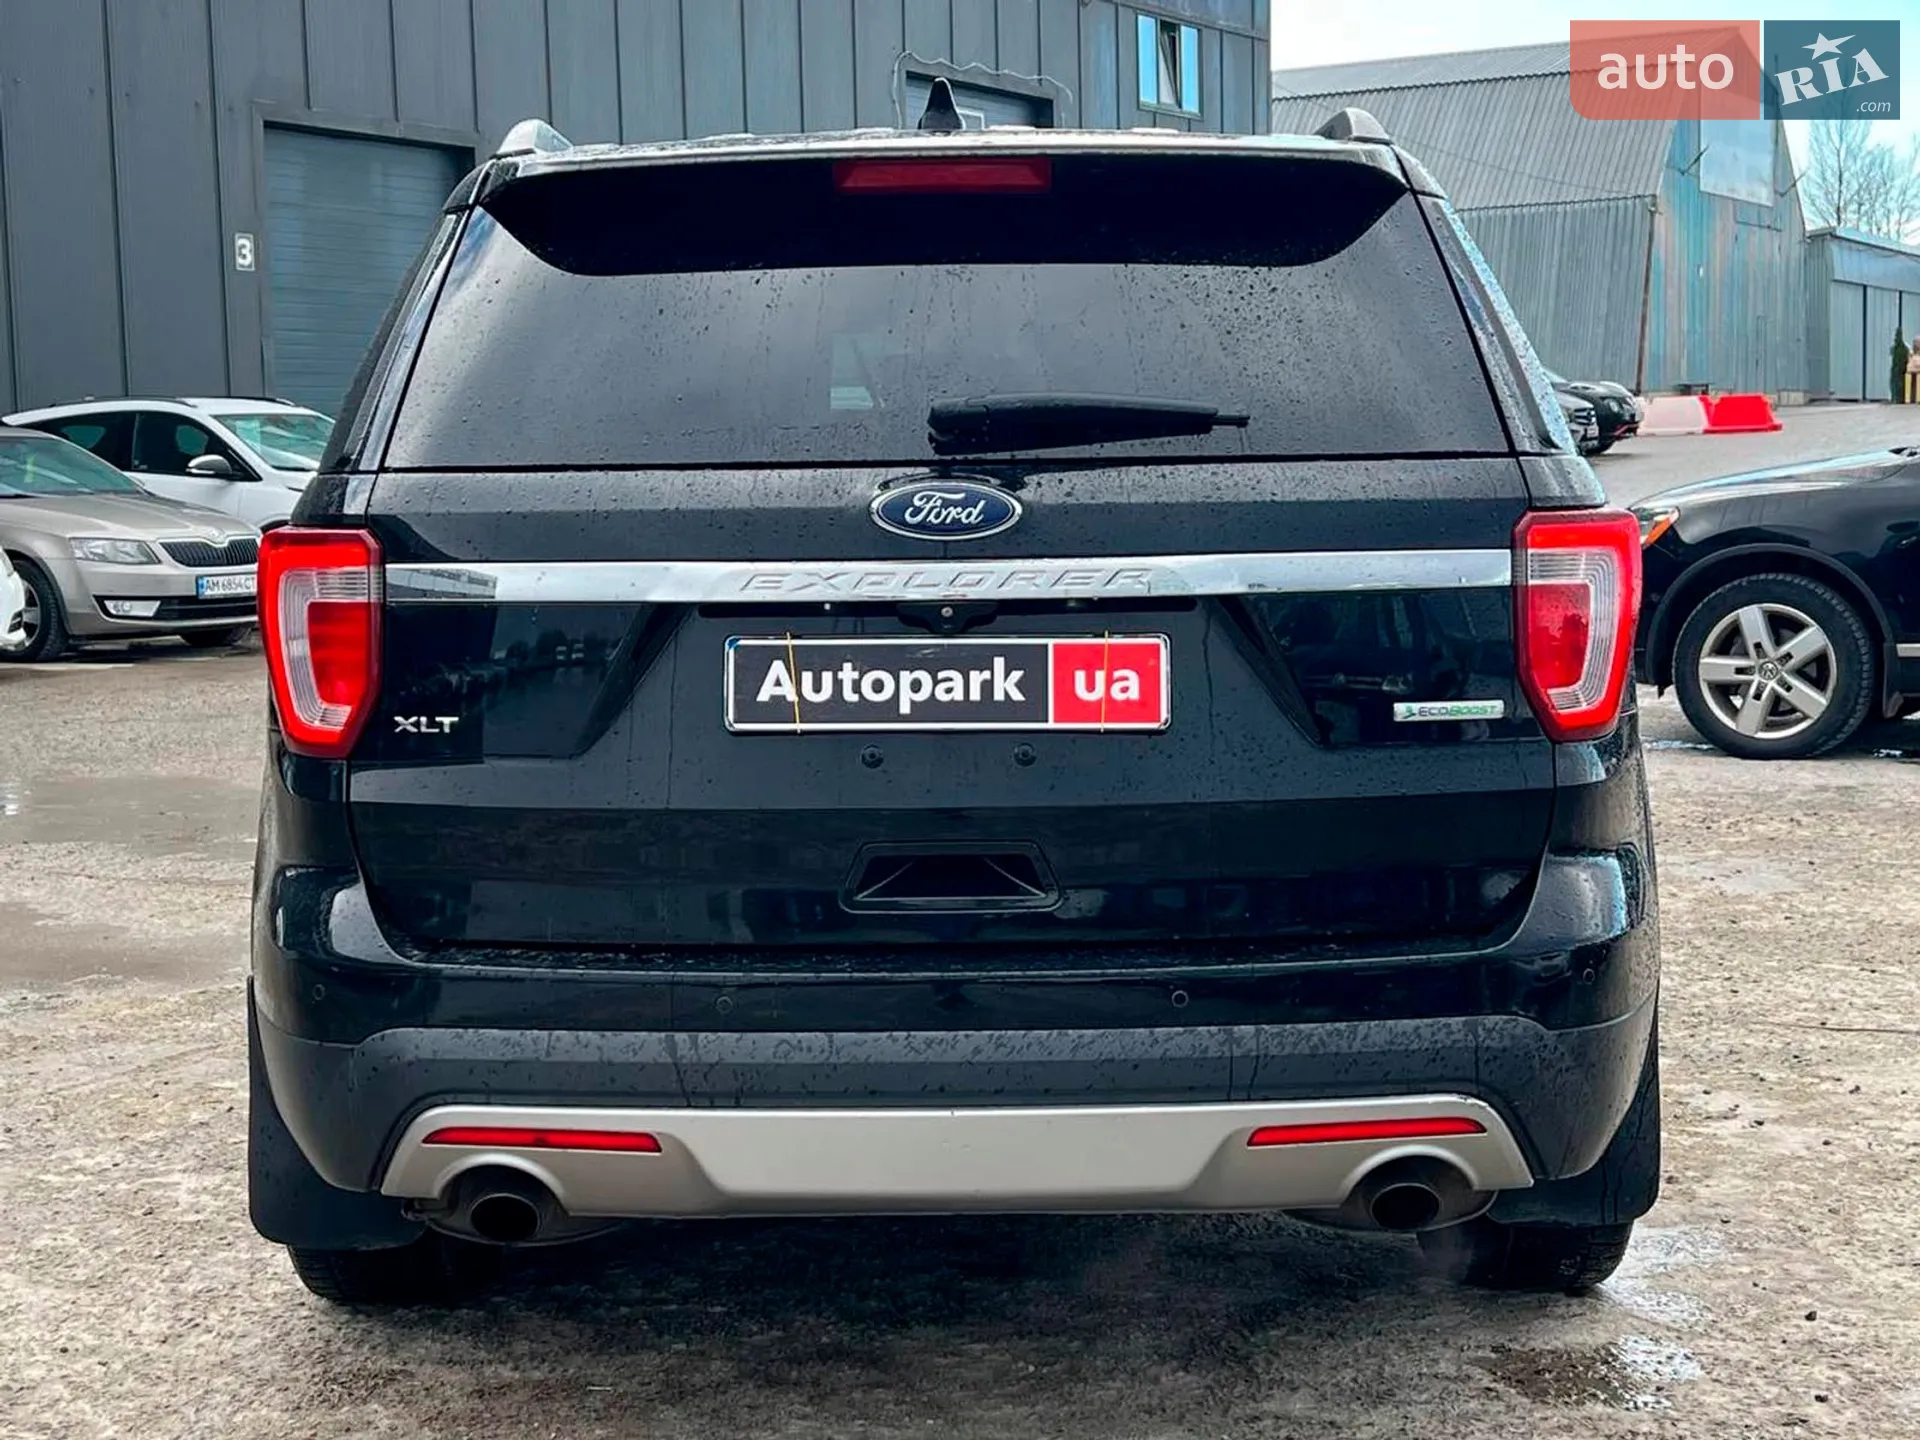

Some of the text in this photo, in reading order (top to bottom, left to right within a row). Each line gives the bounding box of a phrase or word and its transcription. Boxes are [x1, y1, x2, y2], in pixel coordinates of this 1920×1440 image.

[238, 238, 252, 266] 3
[904, 490, 985, 525] Ford
[739, 567, 1154, 593] EXPLORER
[756, 655, 1141, 714] Autopark ua
[393, 715, 460, 734] XLT
[1418, 704, 1498, 718] ECOBOOST
